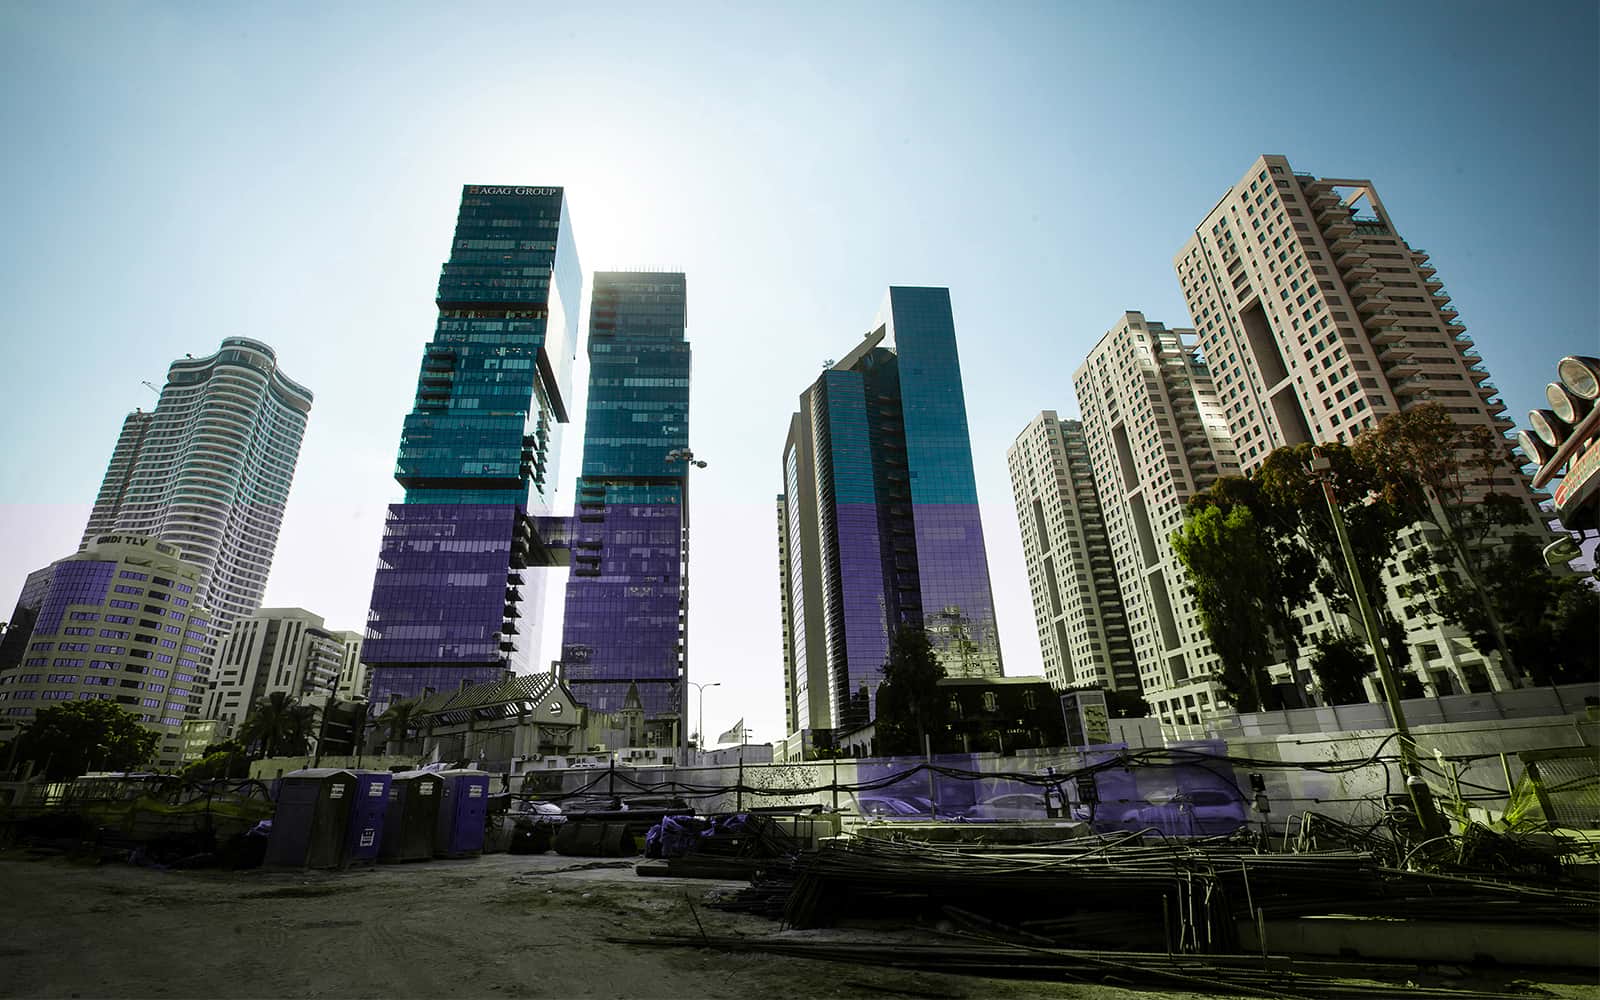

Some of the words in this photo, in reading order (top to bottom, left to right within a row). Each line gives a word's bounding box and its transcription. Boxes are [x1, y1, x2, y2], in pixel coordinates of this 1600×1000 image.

[469, 186, 512, 195] HAGAG
[515, 186, 556, 196] GROUP
[125, 536, 148, 547] TLV
